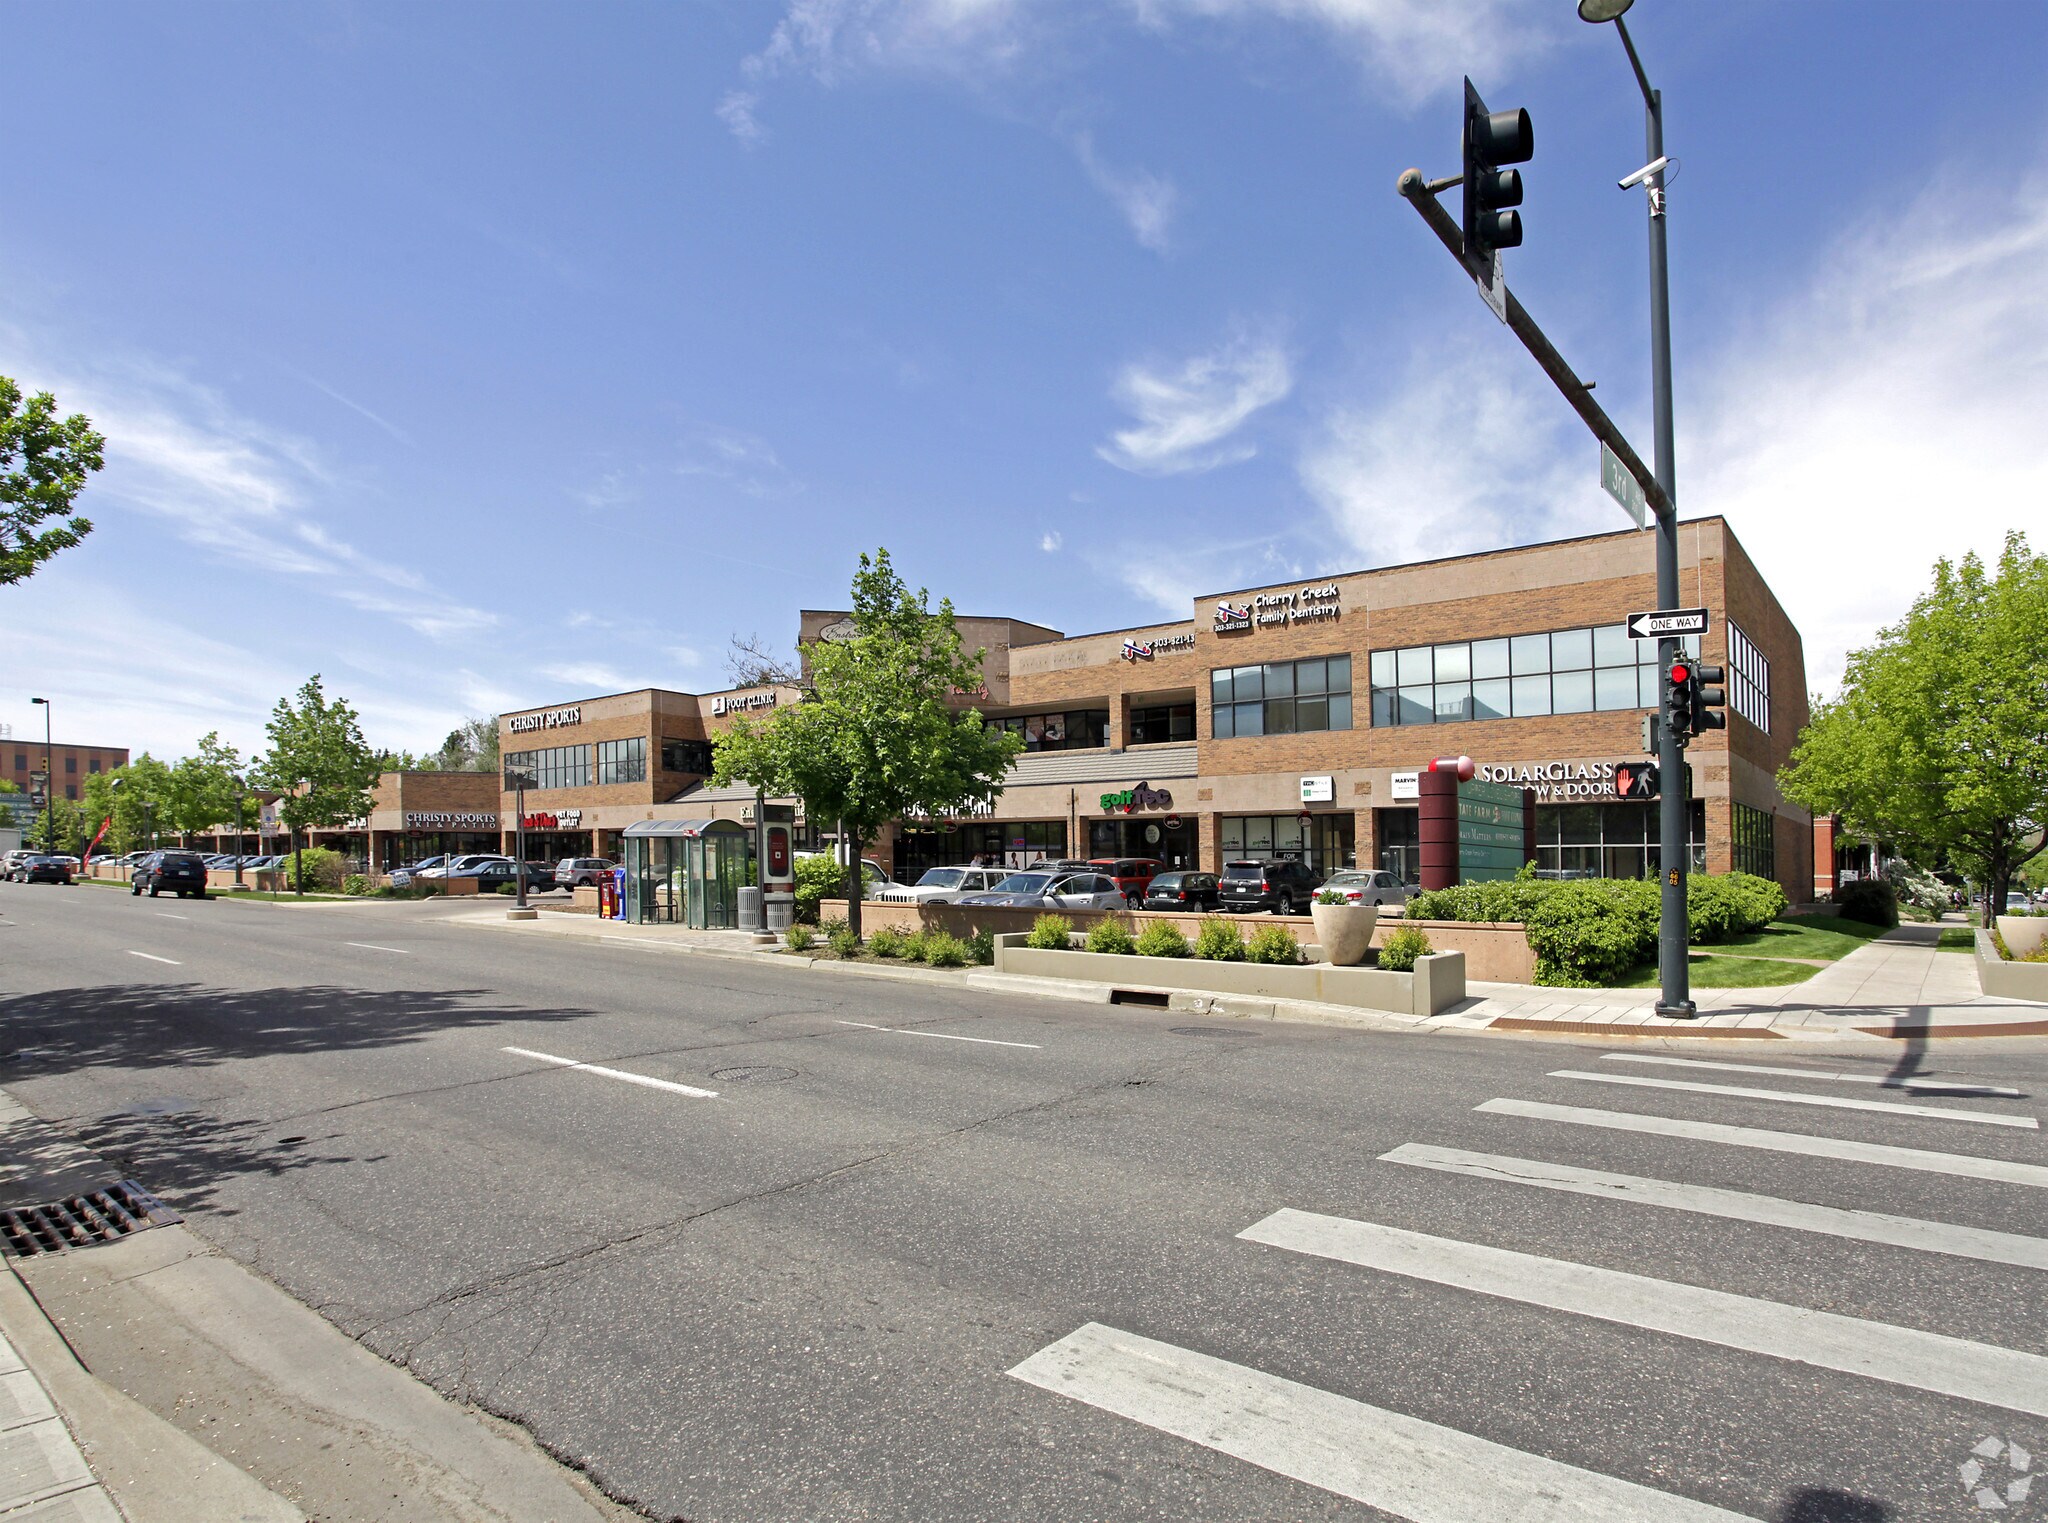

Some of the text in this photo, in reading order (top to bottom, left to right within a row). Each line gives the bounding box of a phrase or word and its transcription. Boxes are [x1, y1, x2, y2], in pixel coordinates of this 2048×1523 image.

[1612, 463, 1627, 501] 3rd
[1254, 583, 1338, 607] Cherry Creek
[1255, 605, 1339, 624] Family Dentistry
[1214, 620, 1249, 632] 303-321-1323
[1651, 616, 1699, 630] ONE WAY
[1154, 634, 1195, 647] 303-321-13
[726, 692, 775, 709] FOOT CLINIC
[509, 706, 580, 731] CHRISTY SPORTS
[1481, 762, 1613, 783] SOLARGLASS
[1553, 785, 1563, 796] &
[1567, 783, 1615, 796] DOOR
[406, 813, 496, 823] CHRISTY SPORTS
[567, 810, 580, 818] FOOD
[560, 818, 577, 827] OUTLET
